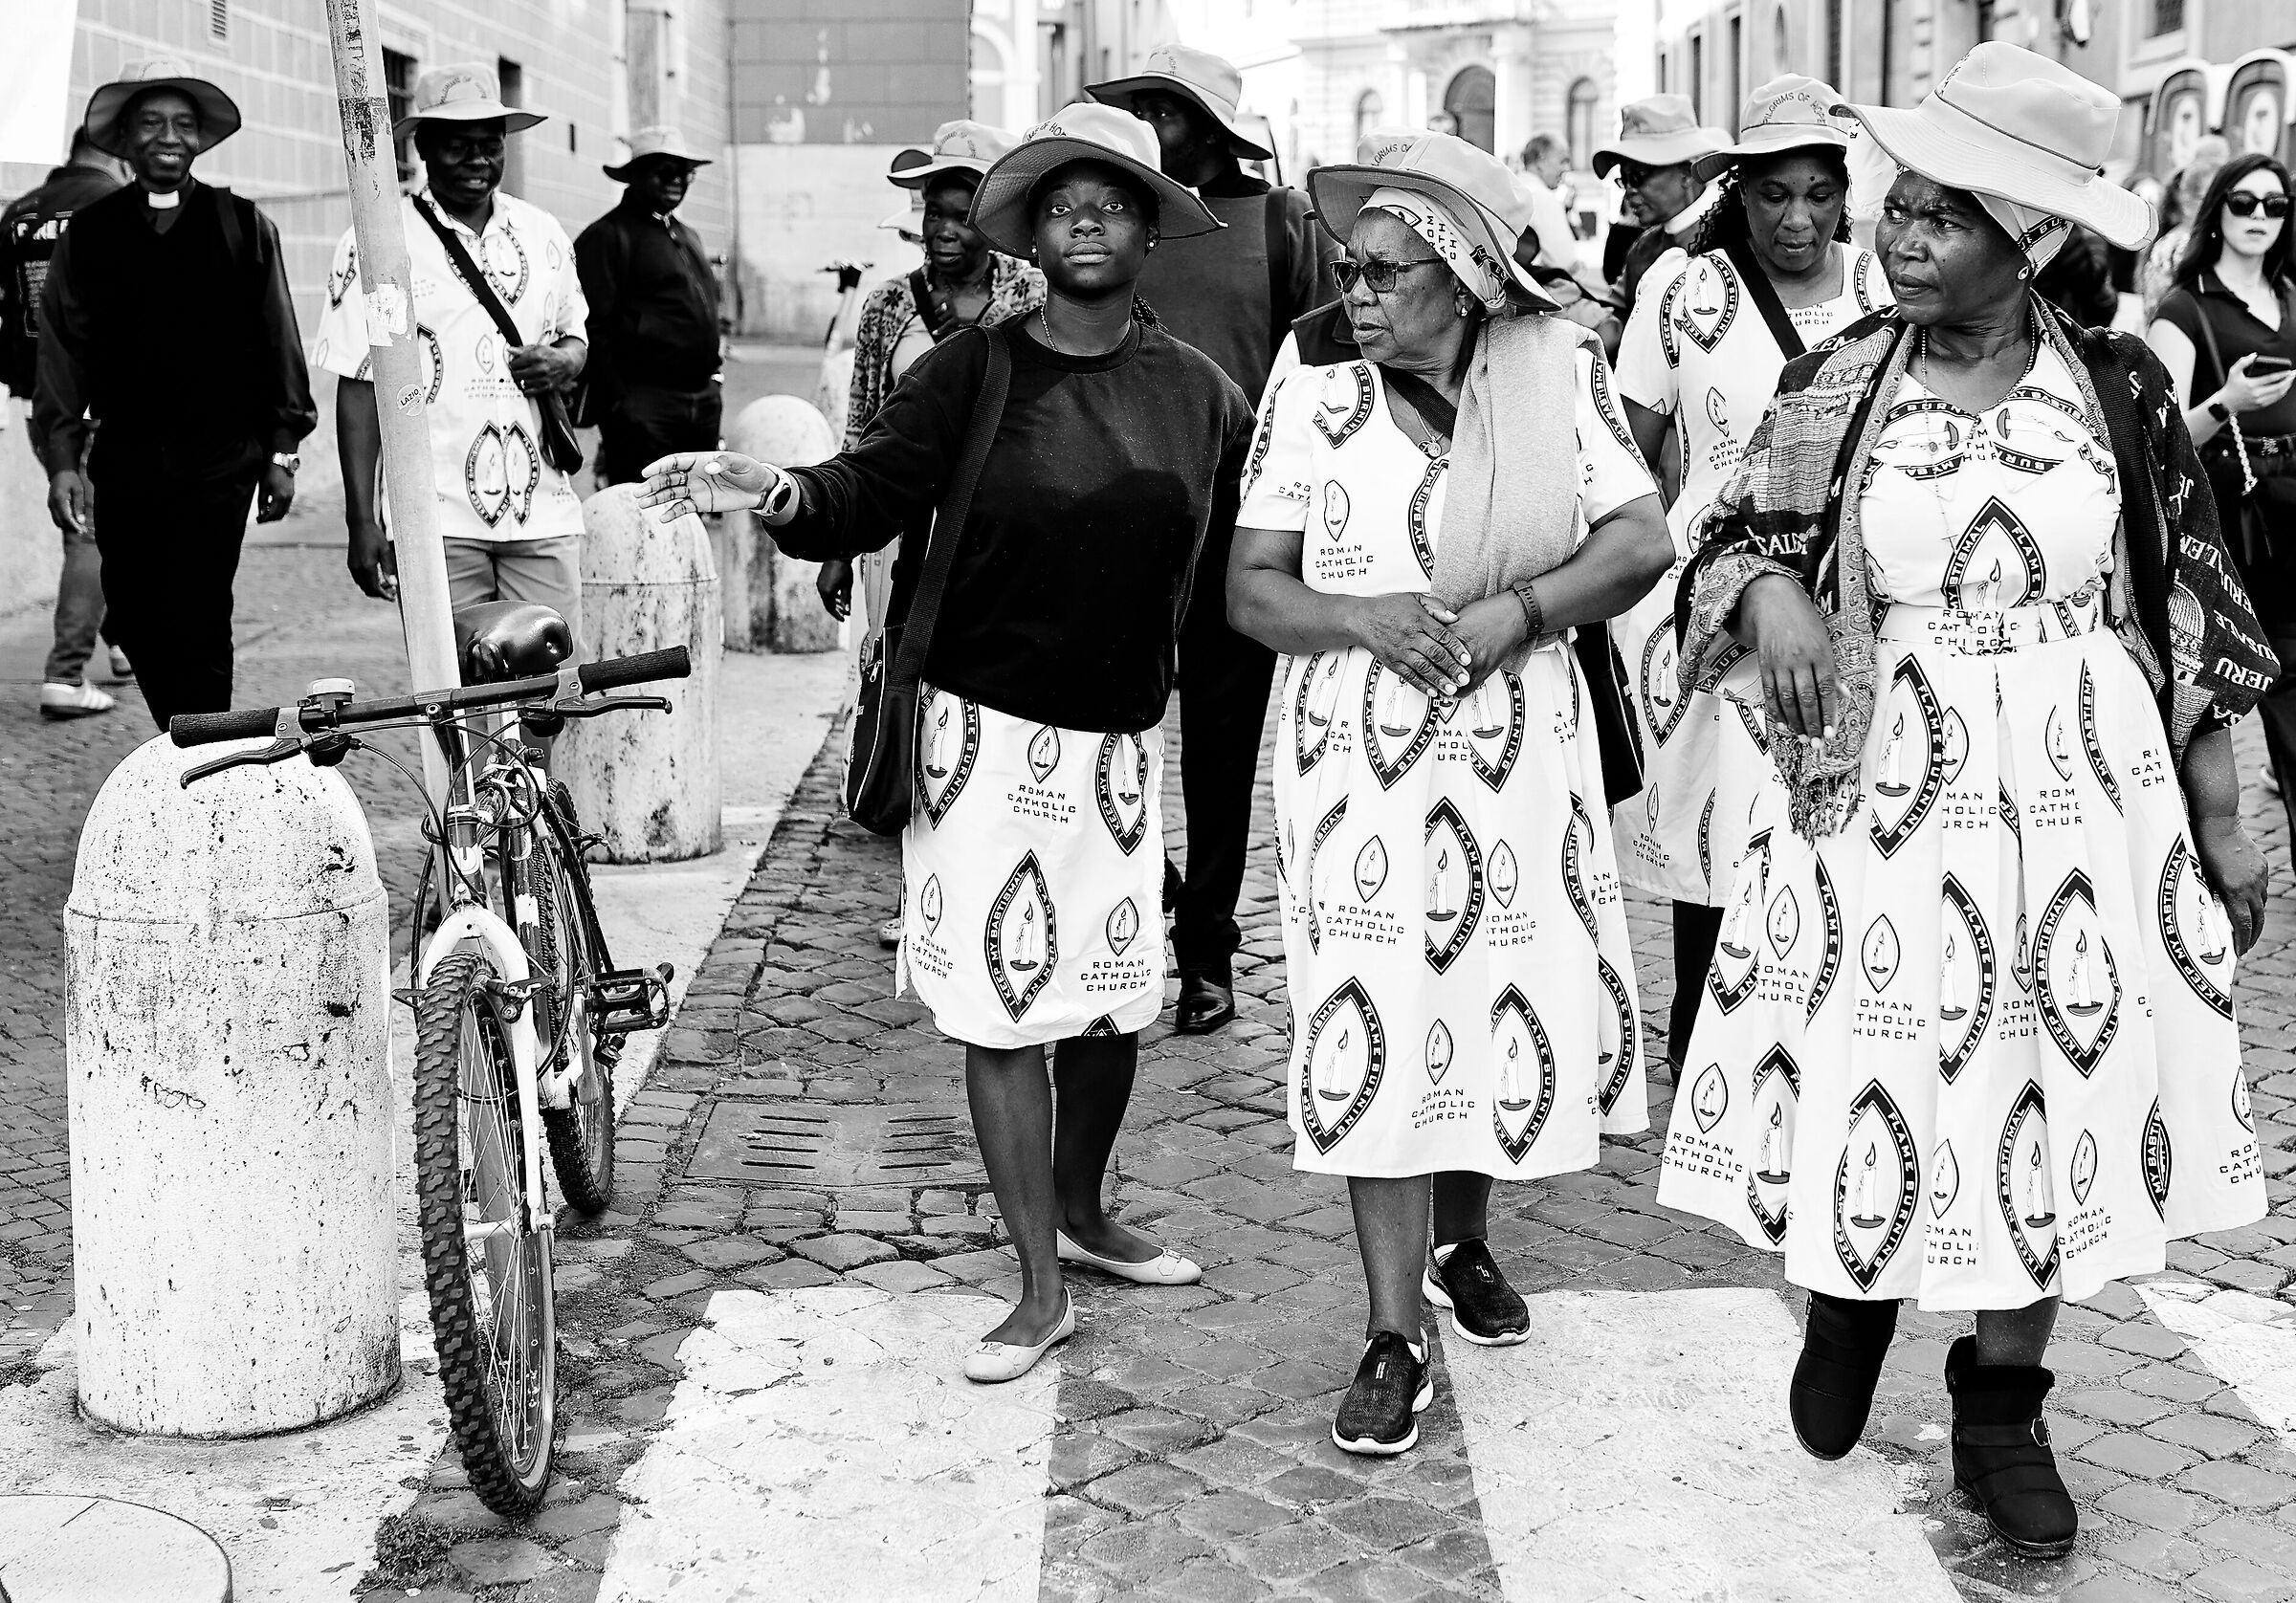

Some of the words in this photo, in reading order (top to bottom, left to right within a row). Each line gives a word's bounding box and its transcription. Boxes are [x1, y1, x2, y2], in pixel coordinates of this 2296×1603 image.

[1763, 92, 1794, 123] PILGRIMS
[1798, 93, 1810, 102] OF
[1049, 122, 1066, 136] HO
[1372, 144, 1398, 165] LGRIMS
[1664, 297, 1673, 313] MY
[1714, 287, 1735, 338] BURNING
[1663, 319, 1671, 346] KEEP
[401, 388, 419, 406] LAZIO
[1596, 362, 1613, 419] BABTISMA
[1342, 385, 1371, 435] BURNING
[1907, 403, 1961, 413] BURN
[2031, 392, 2098, 436] BABTISMA
[1612, 425, 1626, 439] MY
[1415, 526, 1424, 545] MY
[1949, 524, 1985, 584] BTISMAL
[2012, 527, 2041, 582] FLAME
[1367, 663, 1381, 702] BABTI
[1366, 706, 1373, 725] MY
[1644, 680, 1648, 694] MY
[1666, 696, 1687, 735] RNING
[1918, 685, 1941, 743] FLAME
[2083, 674, 2097, 751] BABTISMA
[1501, 691, 1521, 770] BURNING
[1101, 734, 1118, 773] BABTI
[1367, 733, 1382, 764] KEEP
[938, 741, 975, 811] BURNING
[2093, 756, 2107, 777] MY
[1019, 784, 1066, 800] ROMAN
[1101, 778, 1108, 794] MY
[1898, 752, 1942, 837] BURNING
[2040, 789, 2075, 799] ROM
[1007, 794, 1076, 813] CATHOLIC
[1013, 806, 1069, 823] CHURCH
[1102, 800, 1120, 832] KEEP
[2036, 816, 2082, 827] CHUR
[1456, 823, 1481, 873] FLAME
[1702, 837, 1707, 851] MY
[1570, 880, 1582, 900] MY
[2163, 850, 2185, 934] BABTISMAL
[991, 870, 1025, 937] BABTISMAL
[1338, 905, 1395, 920] ROMAN
[1821, 884, 1838, 946] FLAME
[1327, 916, 1404, 934] CATHOLIC
[1449, 880, 1482, 953] BURNING
[1487, 921, 1536, 933] THOLIC
[920, 934, 947, 955] ROMAN
[1329, 929, 1397, 944] CHURCH
[1489, 934, 1534, 947] HURCH
[1962, 903, 1992, 964] FLAME
[2039, 895, 2068, 980] BABTISMAL
[912, 942, 954, 970] CATHOLIC
[989, 943, 999, 960] MY
[2170, 939, 2185, 959] MY
[915, 955, 948, 979] CHURCH
[1024, 933, 1055, 1002] BURNING
[1080, 969, 1151, 980] CATHOLIC
[1093, 959, 1144, 969] ROMAN
[991, 967, 1012, 998] KEEP
[1086, 980, 1146, 992] CHURCH
[1601, 969, 1626, 1013] FLAME
[2183, 965, 2215, 1000] KEEP
[1758, 993, 1803, 1004] HURC
[1860, 999, 1912, 1012] OMAN
[2002, 999, 2034, 1009] ROM
[2039, 985, 2052, 1009] MY
[1857, 1013, 1926, 1027] THOLIC
[1958, 973, 1993, 1061] BURNING
[1362, 1005, 1381, 1056] FLAME
[1524, 1009, 1548, 1057] FLAME
[1853, 1027, 1916, 1041] HURCH
[2048, 1014, 2076, 1050] KEEP
[1609, 1020, 1632, 1095] BURNING
[1336, 1063, 1380, 1135] BURNING
[1423, 1089, 1464, 1104] ROMAN
[1524, 1064, 1553, 1143] BURNING
[1411, 1101, 1475, 1118] CATHOLIC
[1415, 1112, 1468, 1129] CHURCH
[1673, 1132, 1733, 1155] ROMAN
[1888, 1111, 1914, 1173] FLAME
[2000, 1108, 2025, 1197] BABTISMAL
[1664, 1156, 1734, 1183] CHURCH
[1874, 1180, 1915, 1268] BURNING
[2067, 1206, 2106, 1229] ROMAN
[1926, 1224, 1972, 1237] OMAN
[2065, 1232, 2108, 1260] CHURCH
[1928, 1256, 1976, 1265] URCH
